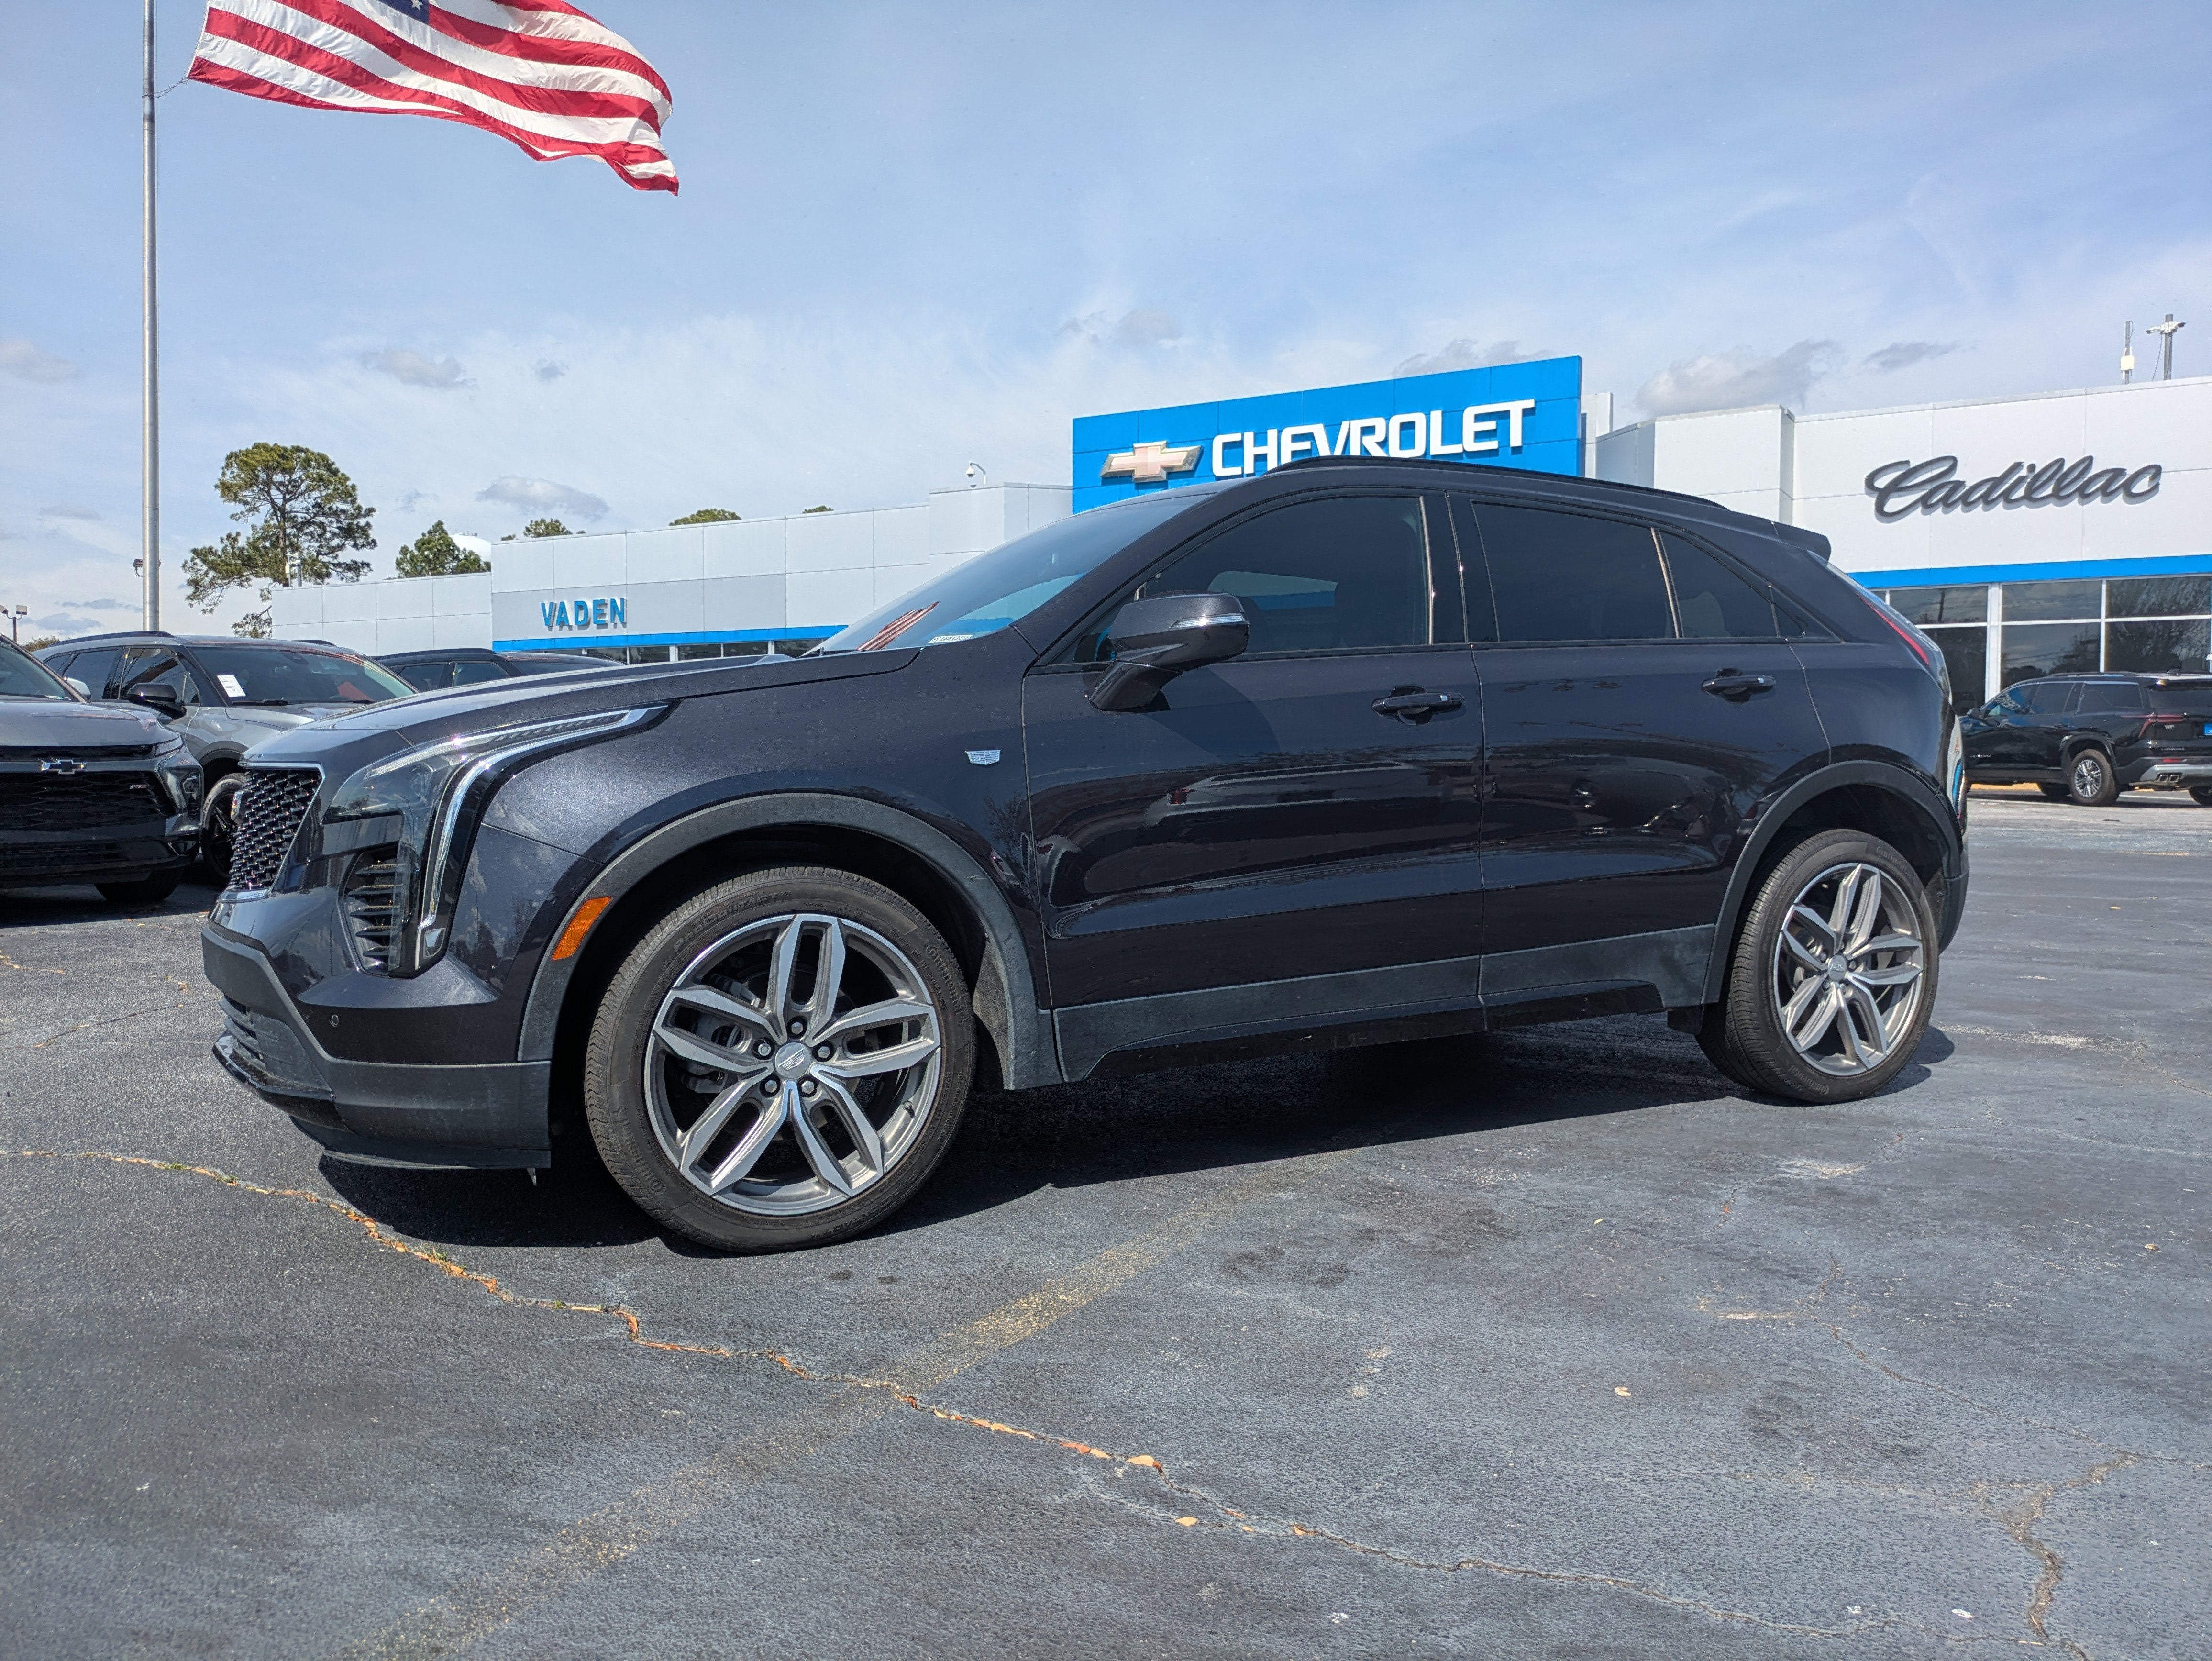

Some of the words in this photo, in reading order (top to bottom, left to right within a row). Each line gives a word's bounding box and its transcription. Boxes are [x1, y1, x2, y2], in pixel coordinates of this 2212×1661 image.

[1212, 399, 1535, 477] CHEVROLET
[1864, 455, 2163, 518] Cadillac
[541, 598, 627, 627] VADEN
[924, 941, 965, 1016] Continental
[615, 1118, 667, 1195] Continental
